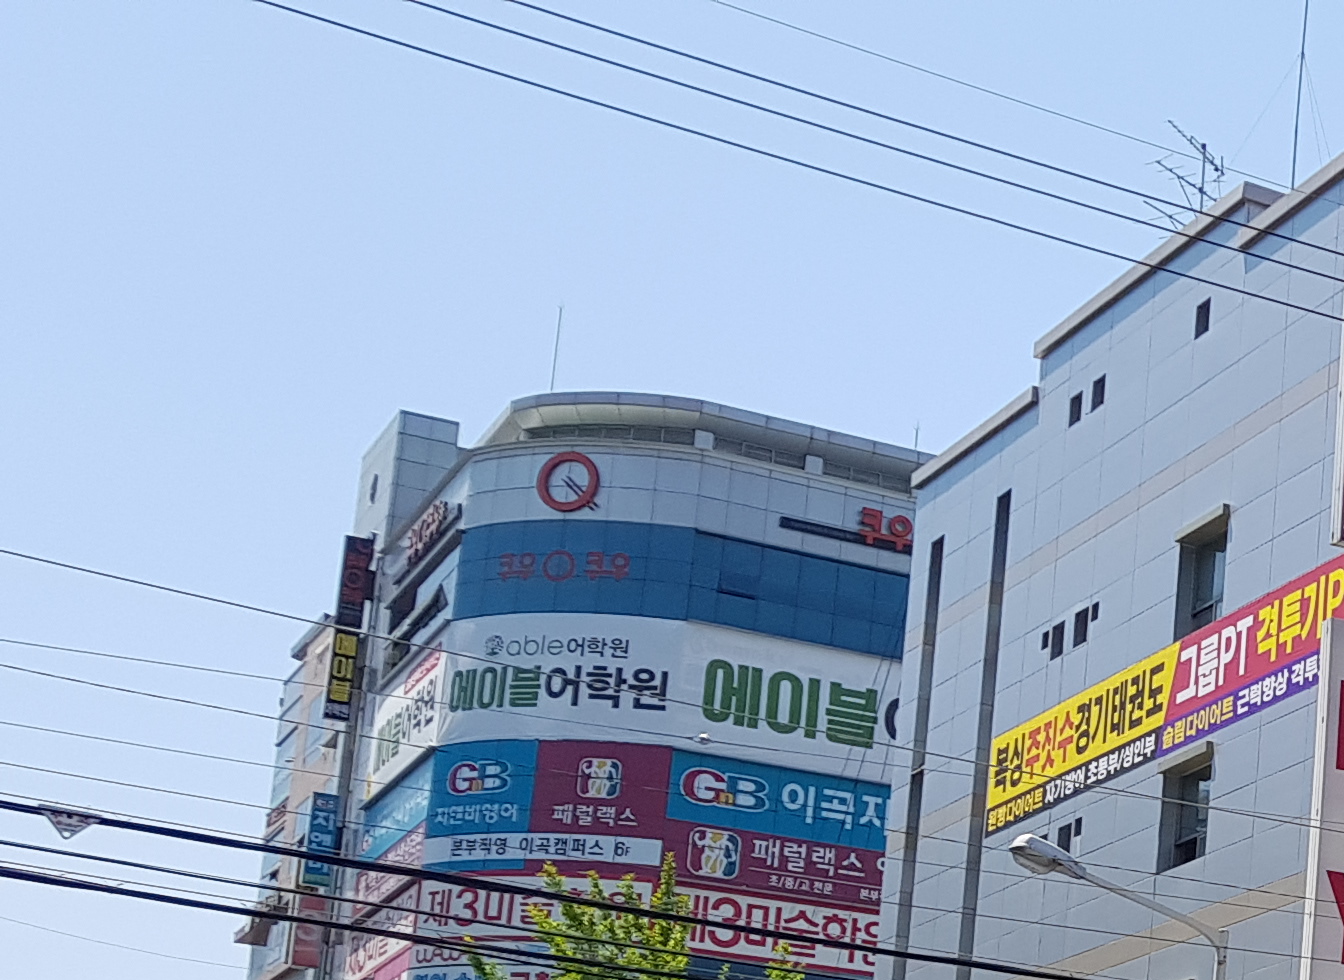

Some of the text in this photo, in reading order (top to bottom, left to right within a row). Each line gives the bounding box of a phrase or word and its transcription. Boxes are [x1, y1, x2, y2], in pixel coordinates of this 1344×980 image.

[1176, 615, 1254, 706] 그룹PT
[450, 664, 670, 713] 에이블어학원
[551, 803, 638, 828] 패럴랙스
[519, 836, 605, 858] 이곡캠퍼스
[750, 838, 866, 878] 패럴랙스
